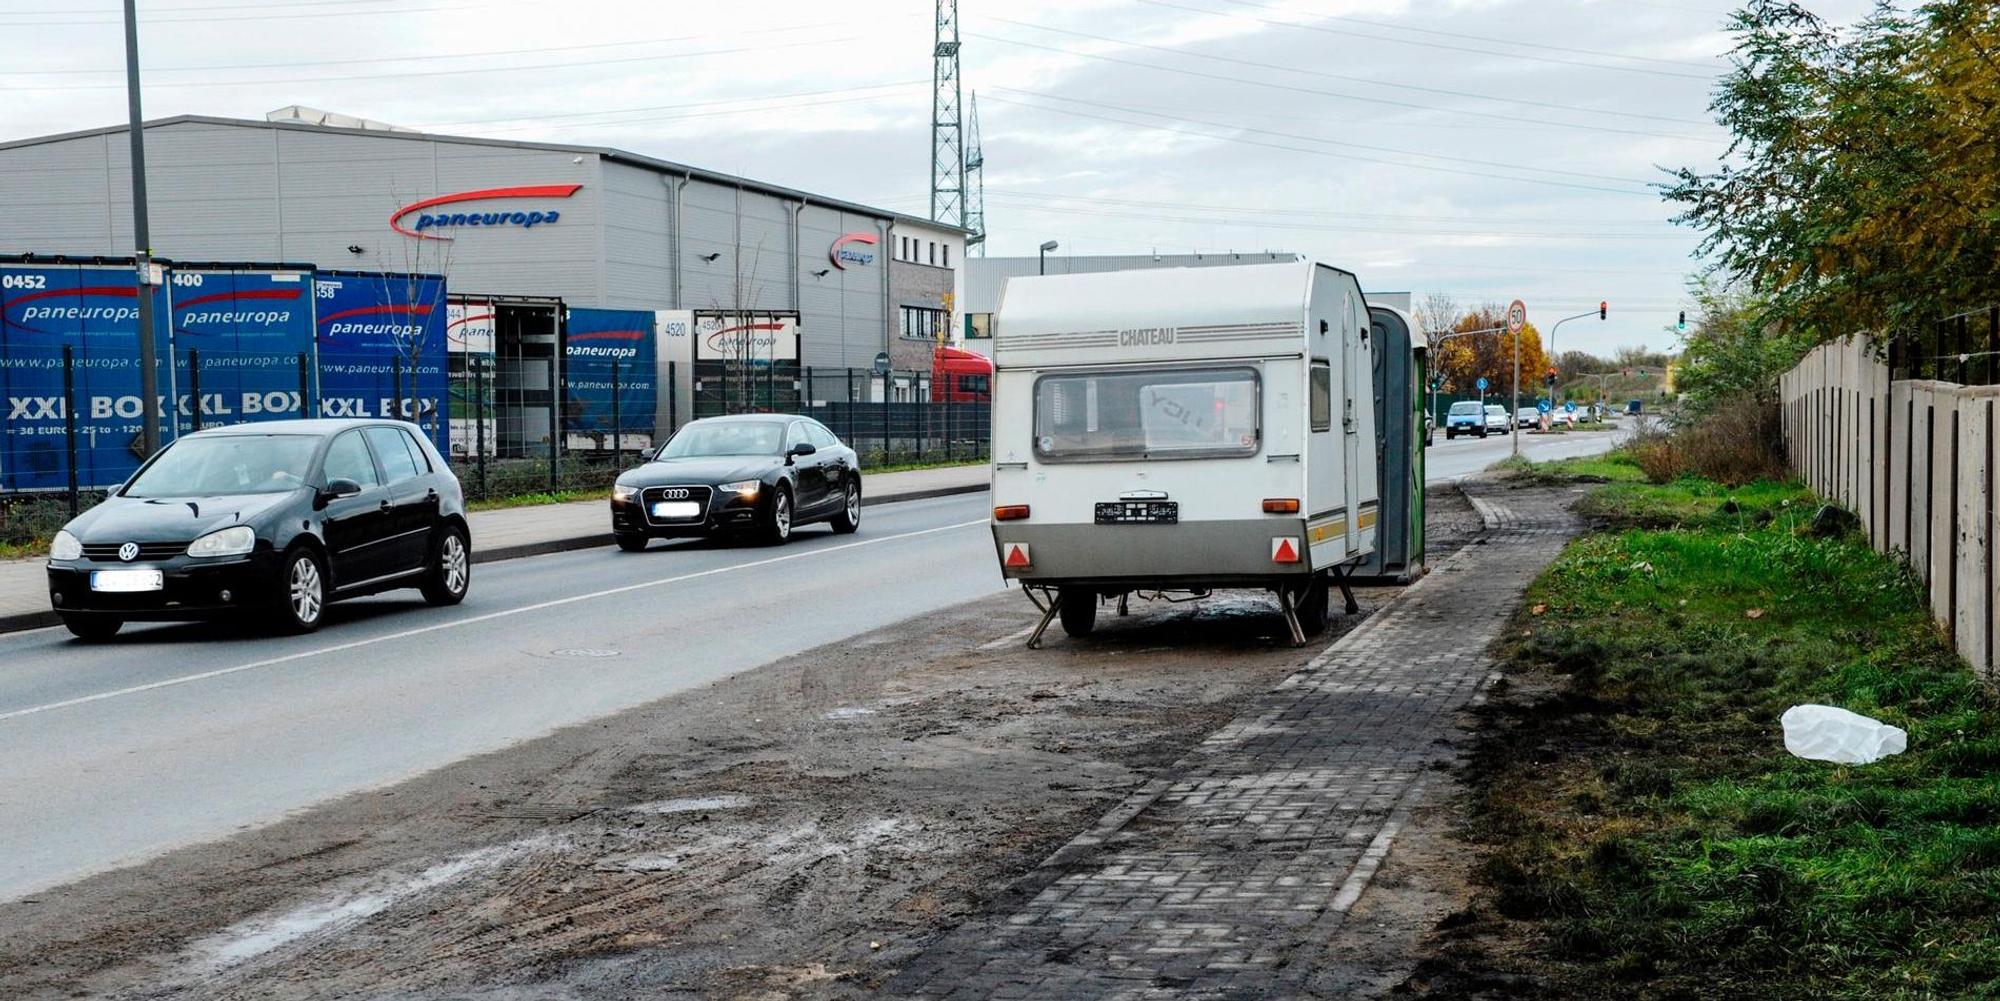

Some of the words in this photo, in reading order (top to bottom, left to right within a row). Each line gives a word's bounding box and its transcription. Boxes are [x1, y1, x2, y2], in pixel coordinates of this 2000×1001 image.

[415, 210, 560, 231] paneuropa
[2, 274, 46, 289] 0452
[174, 274, 203, 287] 400
[22, 306, 140, 322] paneuropa
[182, 311, 290, 327] paneuropa
[329, 323, 422, 338] paneuropa
[665, 323, 686, 337] 4520
[1120, 327, 1174, 346] CHATEAU
[0, 357, 163, 370] www.paeuropa.cm
[19, 426, 34, 435] 38
[82, 426, 96, 434] 25
